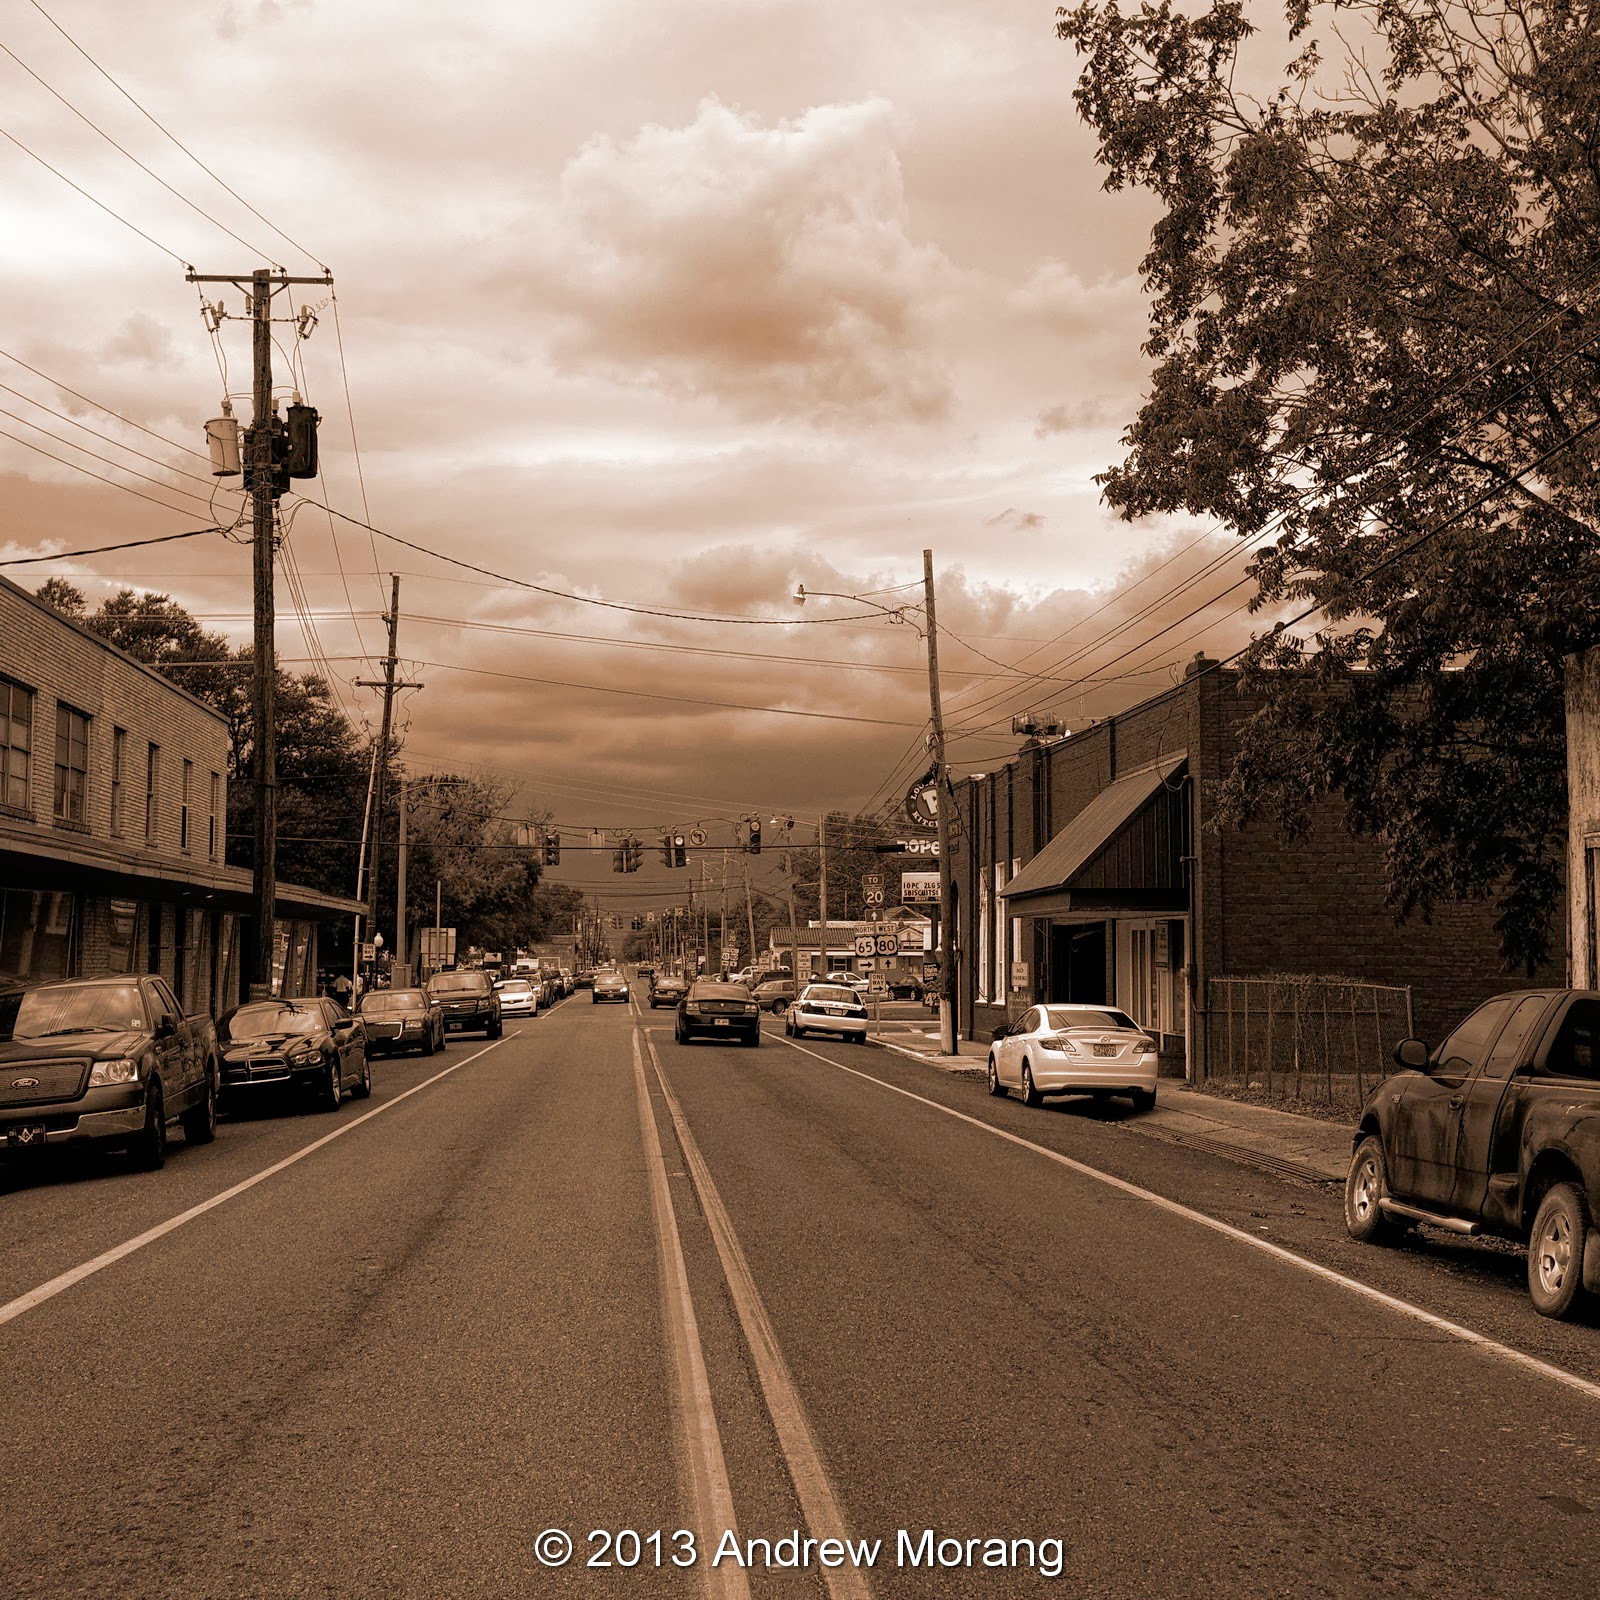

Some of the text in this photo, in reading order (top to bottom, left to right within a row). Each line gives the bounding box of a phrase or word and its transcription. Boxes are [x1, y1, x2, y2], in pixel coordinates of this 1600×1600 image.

[867, 891, 883, 903] 20
[858, 941, 873, 953] 65
[879, 940, 895, 952] 80
